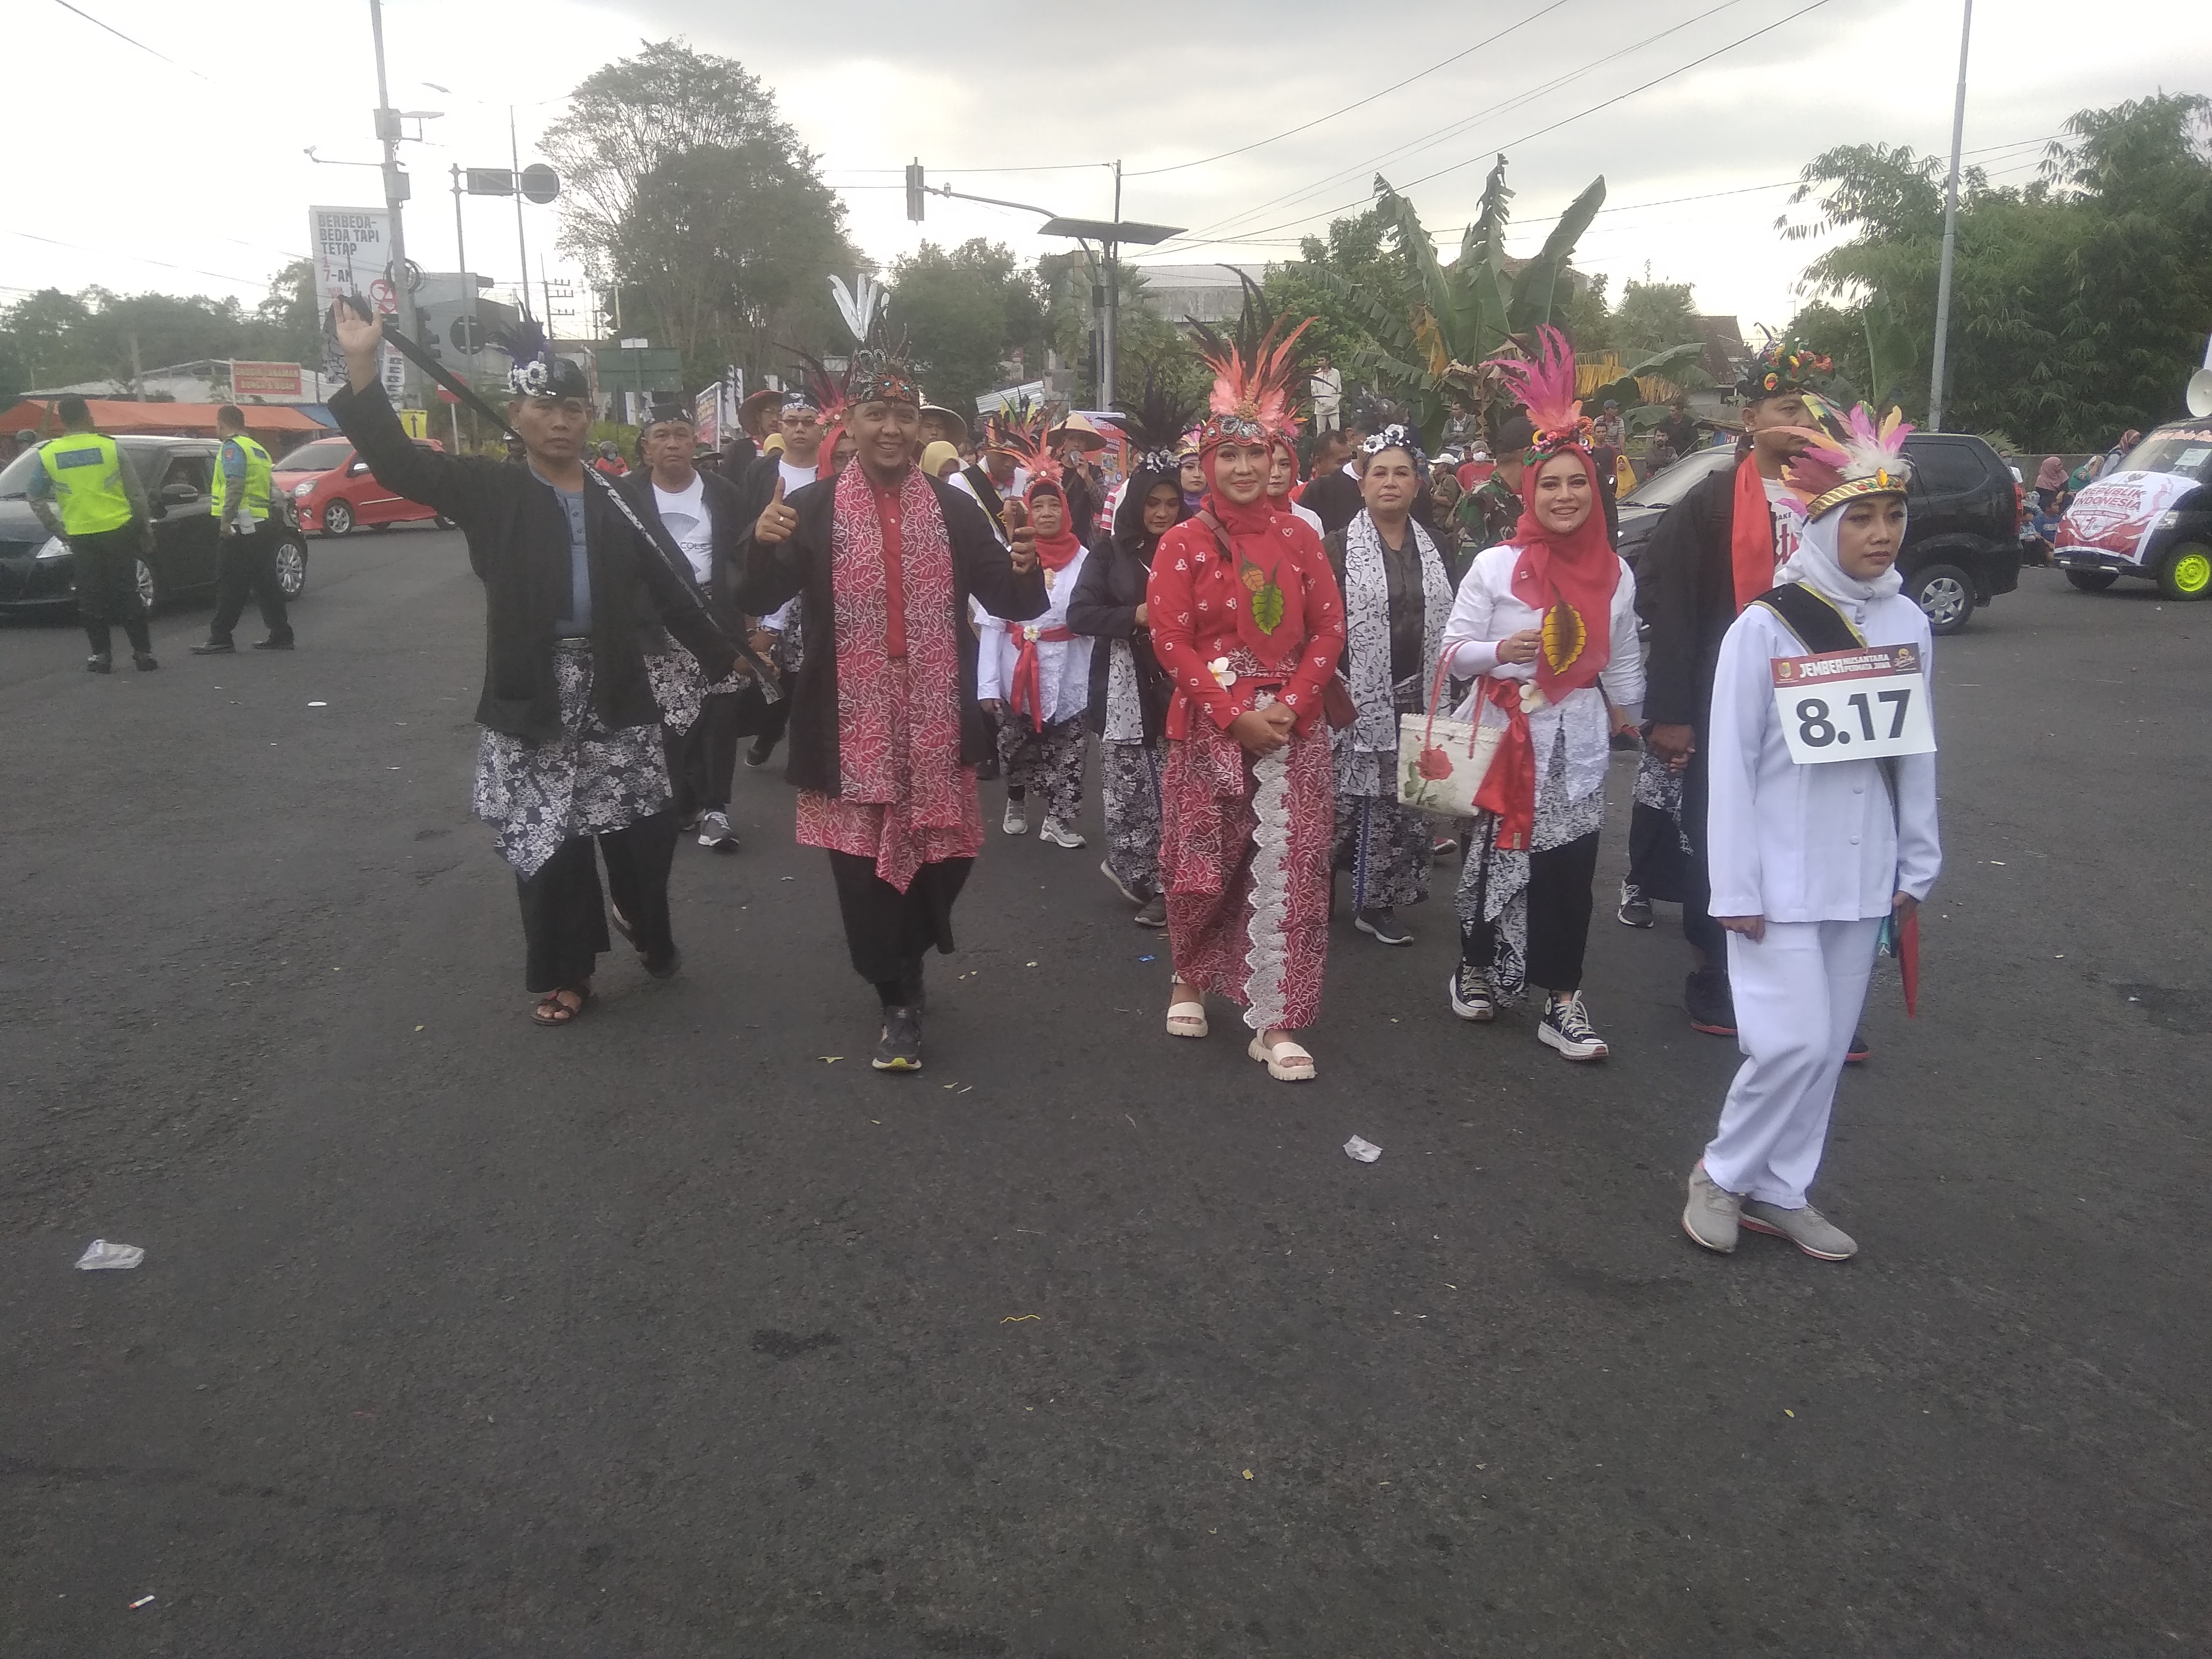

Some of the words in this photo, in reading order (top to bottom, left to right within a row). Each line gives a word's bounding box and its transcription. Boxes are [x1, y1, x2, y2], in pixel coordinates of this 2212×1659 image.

[318, 215, 377, 229] BERBEDA-
[319, 228, 350, 241] BEDA
[353, 229, 379, 242] TAPI
[321, 241, 357, 255] TETAP
[2082, 487, 2146, 499] REPUBLIK
[2073, 496, 2141, 510] INDONESIA
[1842, 653, 1890, 665] NUSANTARA
[1799, 659, 1844, 678] JEMBER
[1797, 689, 1911, 748] 8.17
